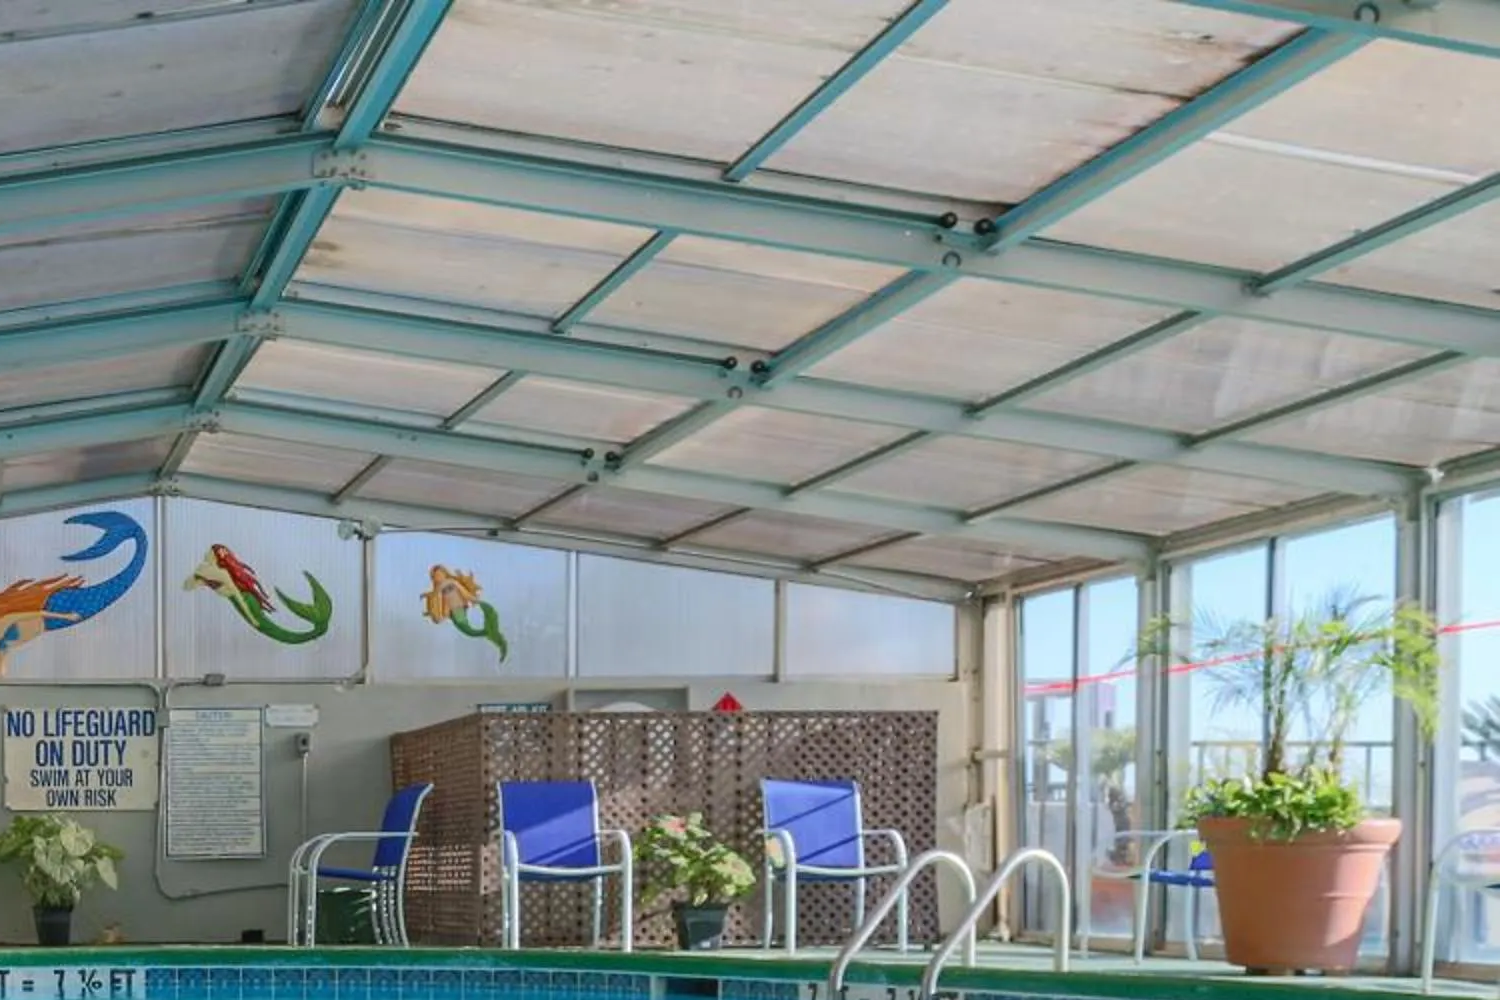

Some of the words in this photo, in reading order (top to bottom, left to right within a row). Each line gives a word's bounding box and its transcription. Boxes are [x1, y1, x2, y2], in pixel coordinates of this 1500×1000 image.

[7, 710, 35, 737] NO
[43, 709, 156, 737] LIFEGUARD
[35, 740, 63, 767] ON
[71, 740, 127, 767] DUTY
[29, 769, 69, 787] SWIM
[75, 769, 92, 787] AT
[97, 769, 134, 787] YOUR
[45, 789, 80, 807] OWN
[85, 789, 116, 807] RISK
